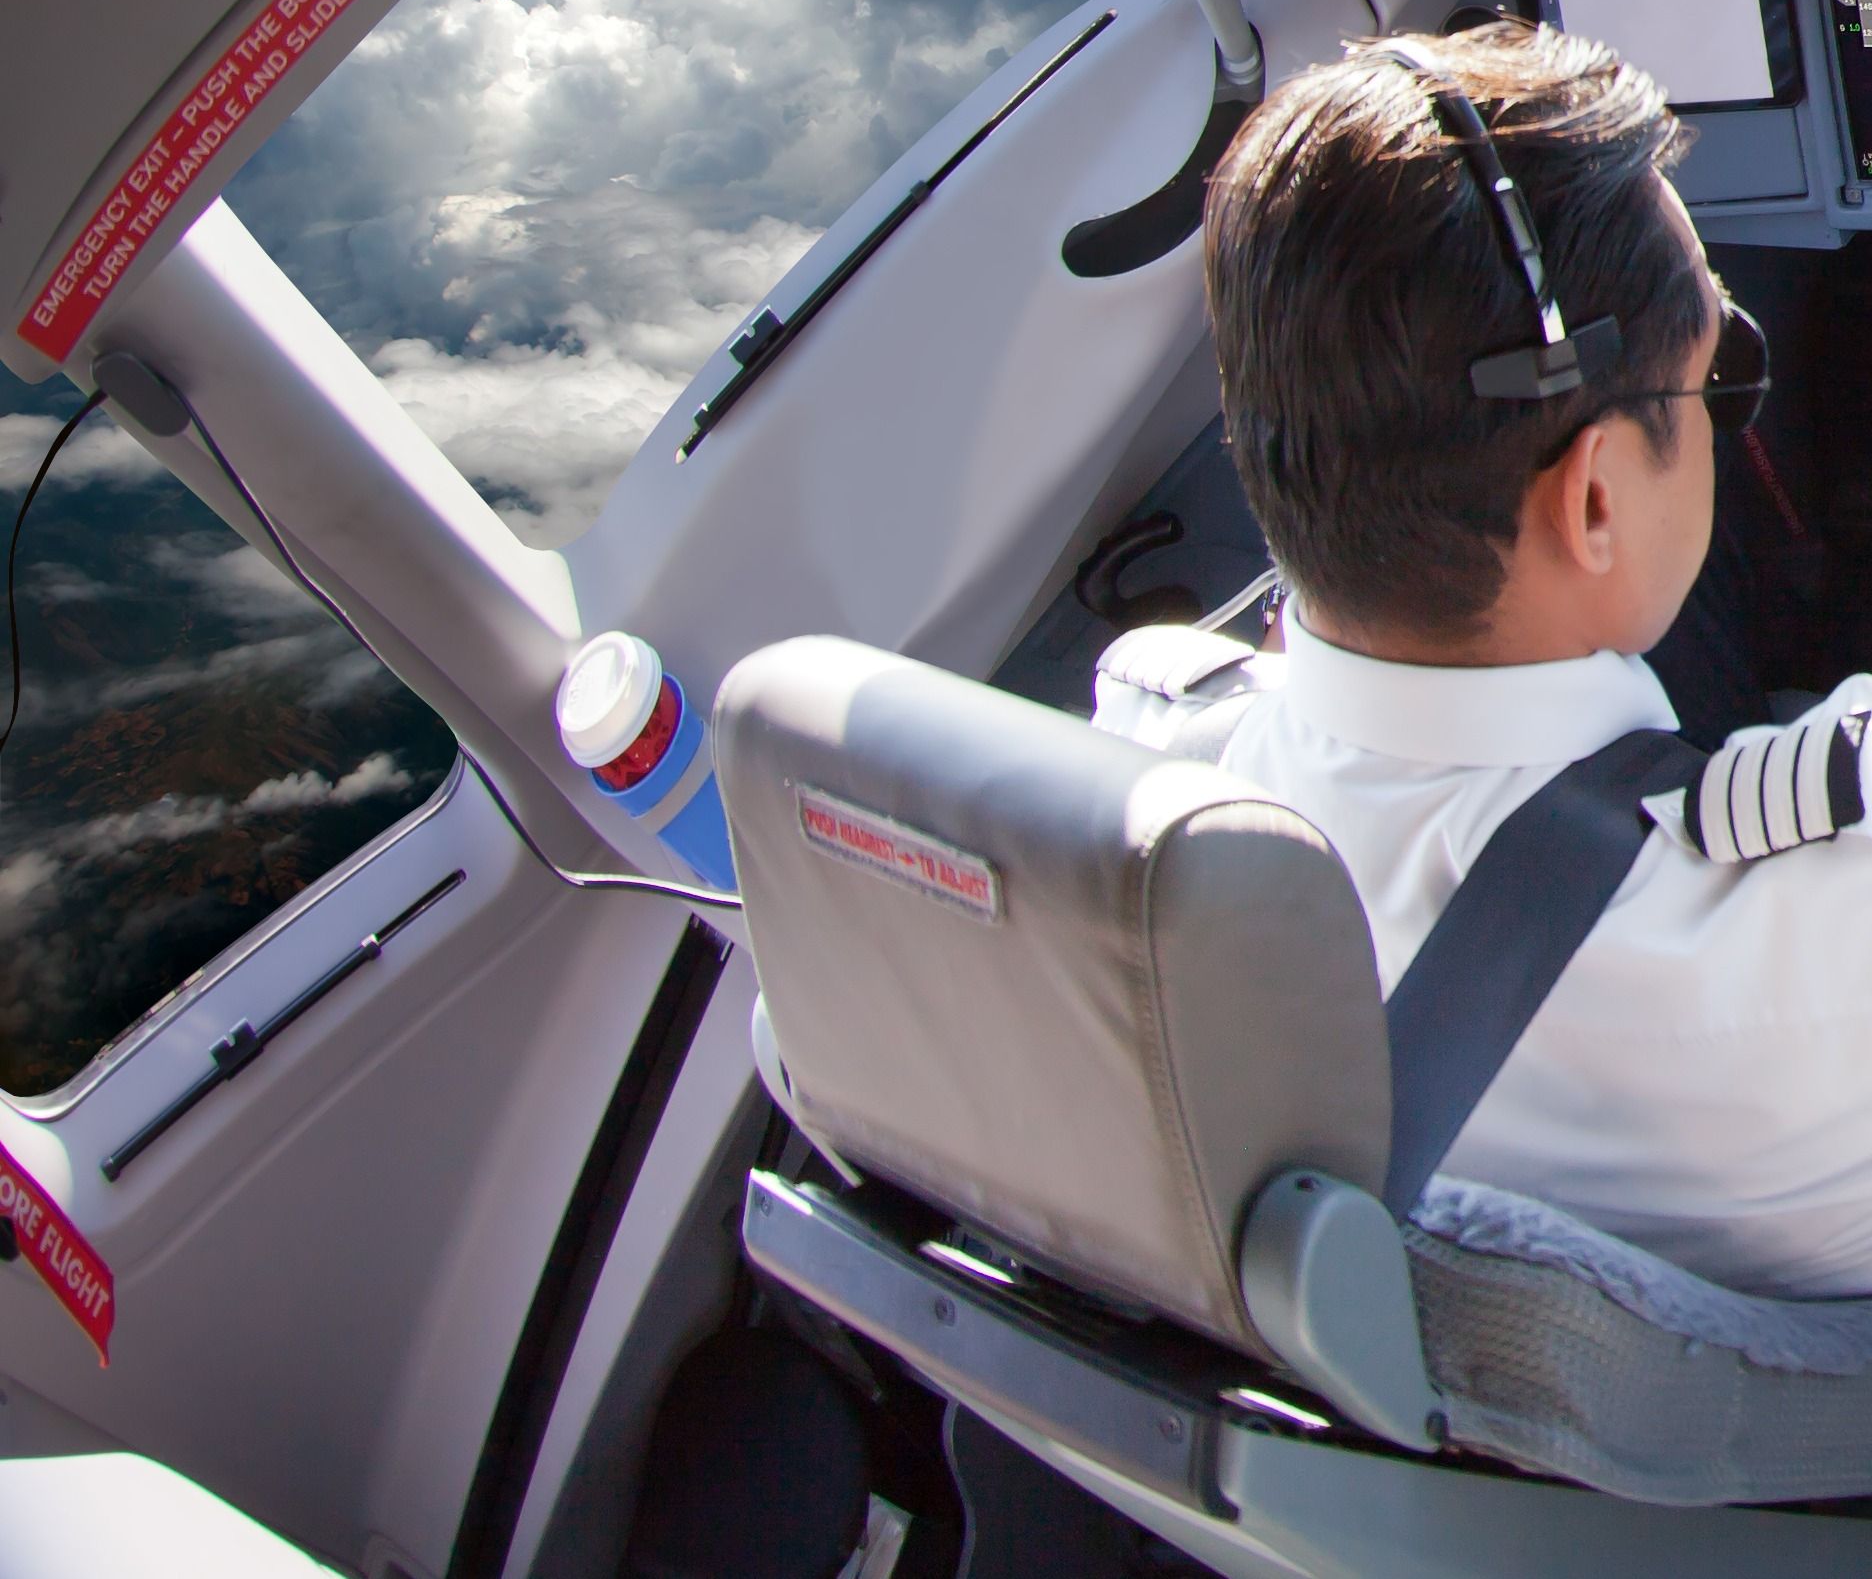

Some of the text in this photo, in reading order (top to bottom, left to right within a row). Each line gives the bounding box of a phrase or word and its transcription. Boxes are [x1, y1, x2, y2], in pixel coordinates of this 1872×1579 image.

[33, 188, 133, 328] EMERGENCY
[129, 137, 172, 194] EXIT
[181, 61, 240, 128] PUSH
[235, 13, 282, 63] THE
[84, 237, 135, 302] TURN
[129, 188, 171, 244] THE
[165, 98, 245, 193] HANDLE
[243, 52, 288, 104] AND
[40, 1223, 109, 1318] FLIGHT
